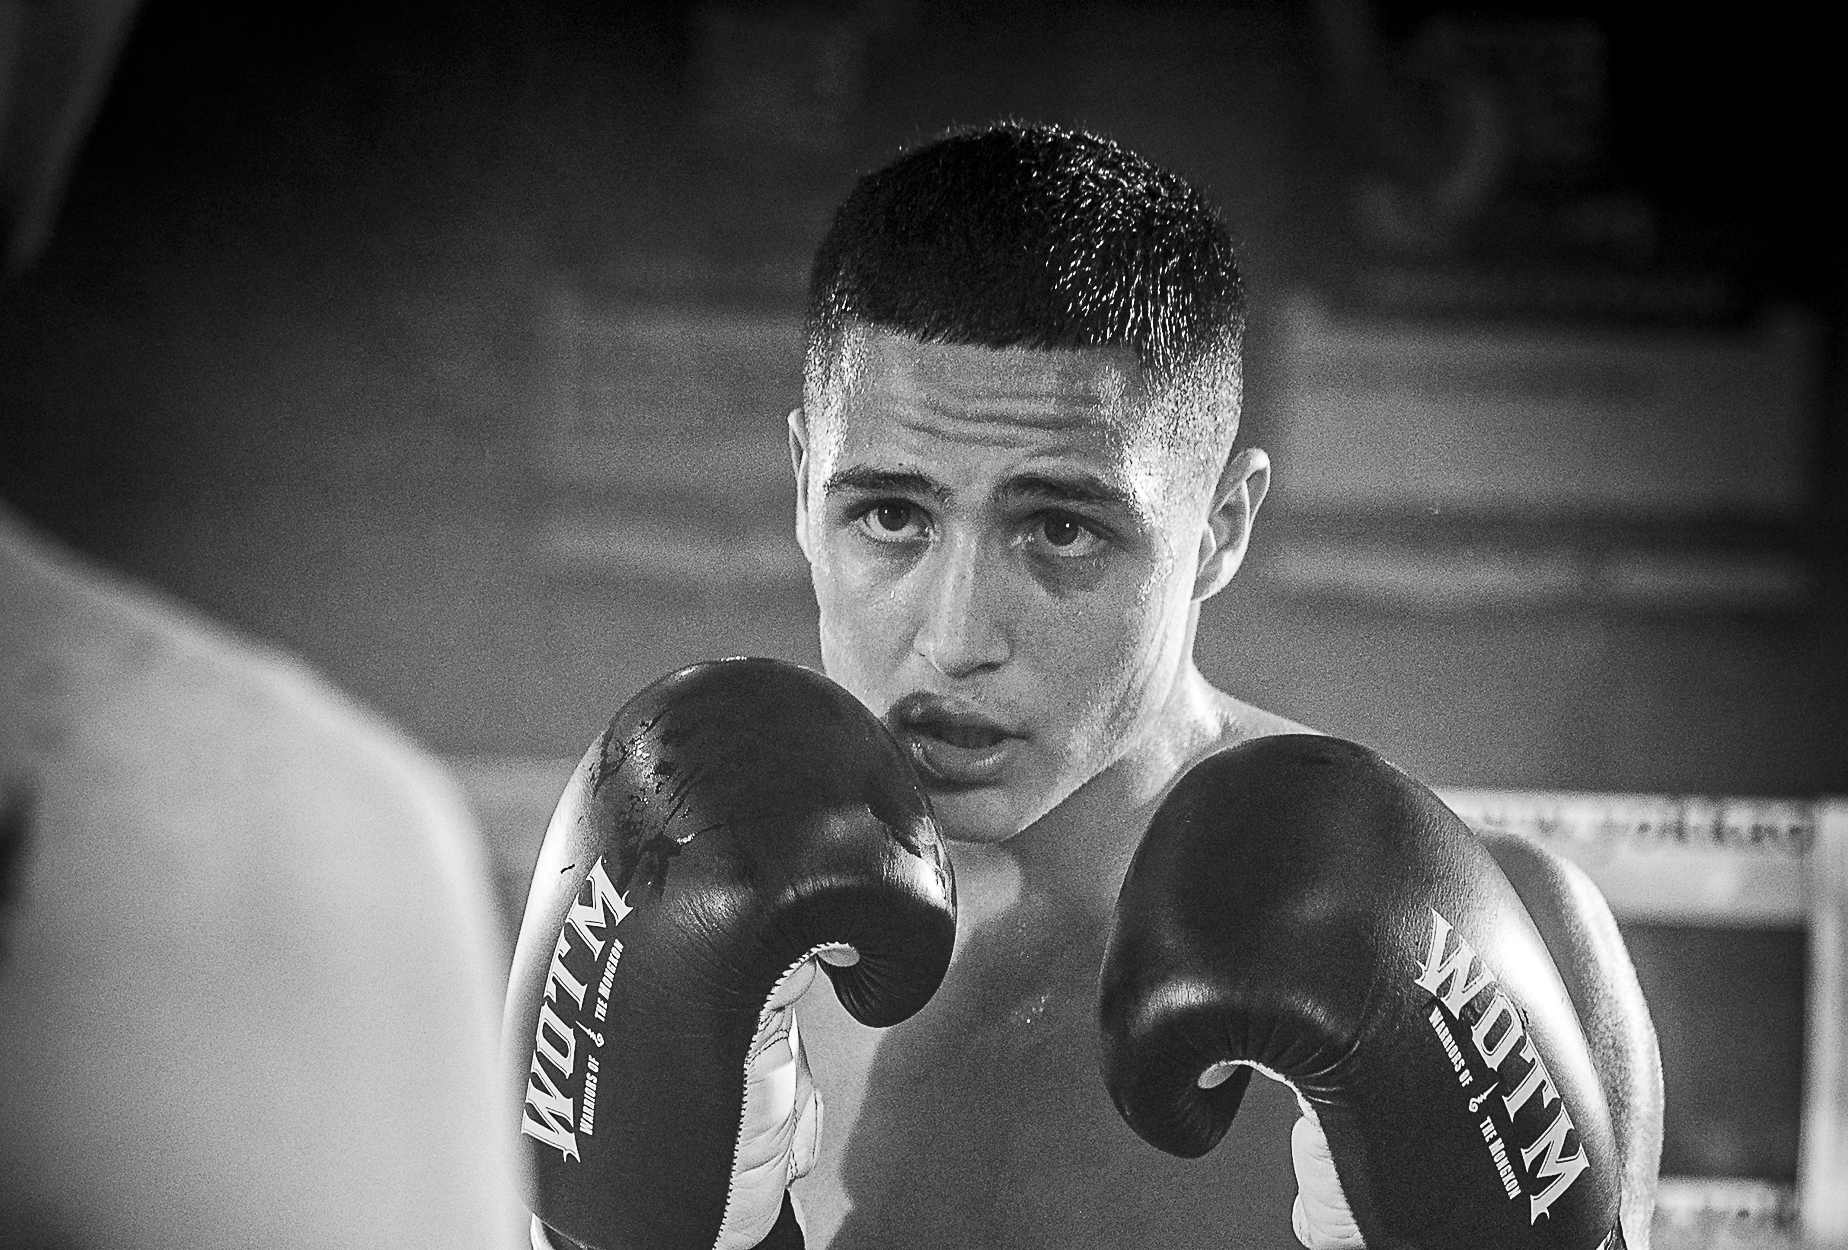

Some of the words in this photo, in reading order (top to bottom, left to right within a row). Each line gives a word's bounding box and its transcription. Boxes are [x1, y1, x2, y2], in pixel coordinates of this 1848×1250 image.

[598, 938, 624, 998] MONGKON
[521, 855, 633, 1163] WOTM
[594, 994, 609, 1022] THE
[587, 1054, 600, 1070] OF
[1414, 908, 1590, 1225] WOTM
[579, 1068, 599, 1136] WARRIORS
[1428, 1004, 1466, 1072] WARRIORS
[1460, 1070, 1474, 1087] OF
[1479, 1115, 1496, 1143] THE
[1488, 1137, 1522, 1200] MONGKON
